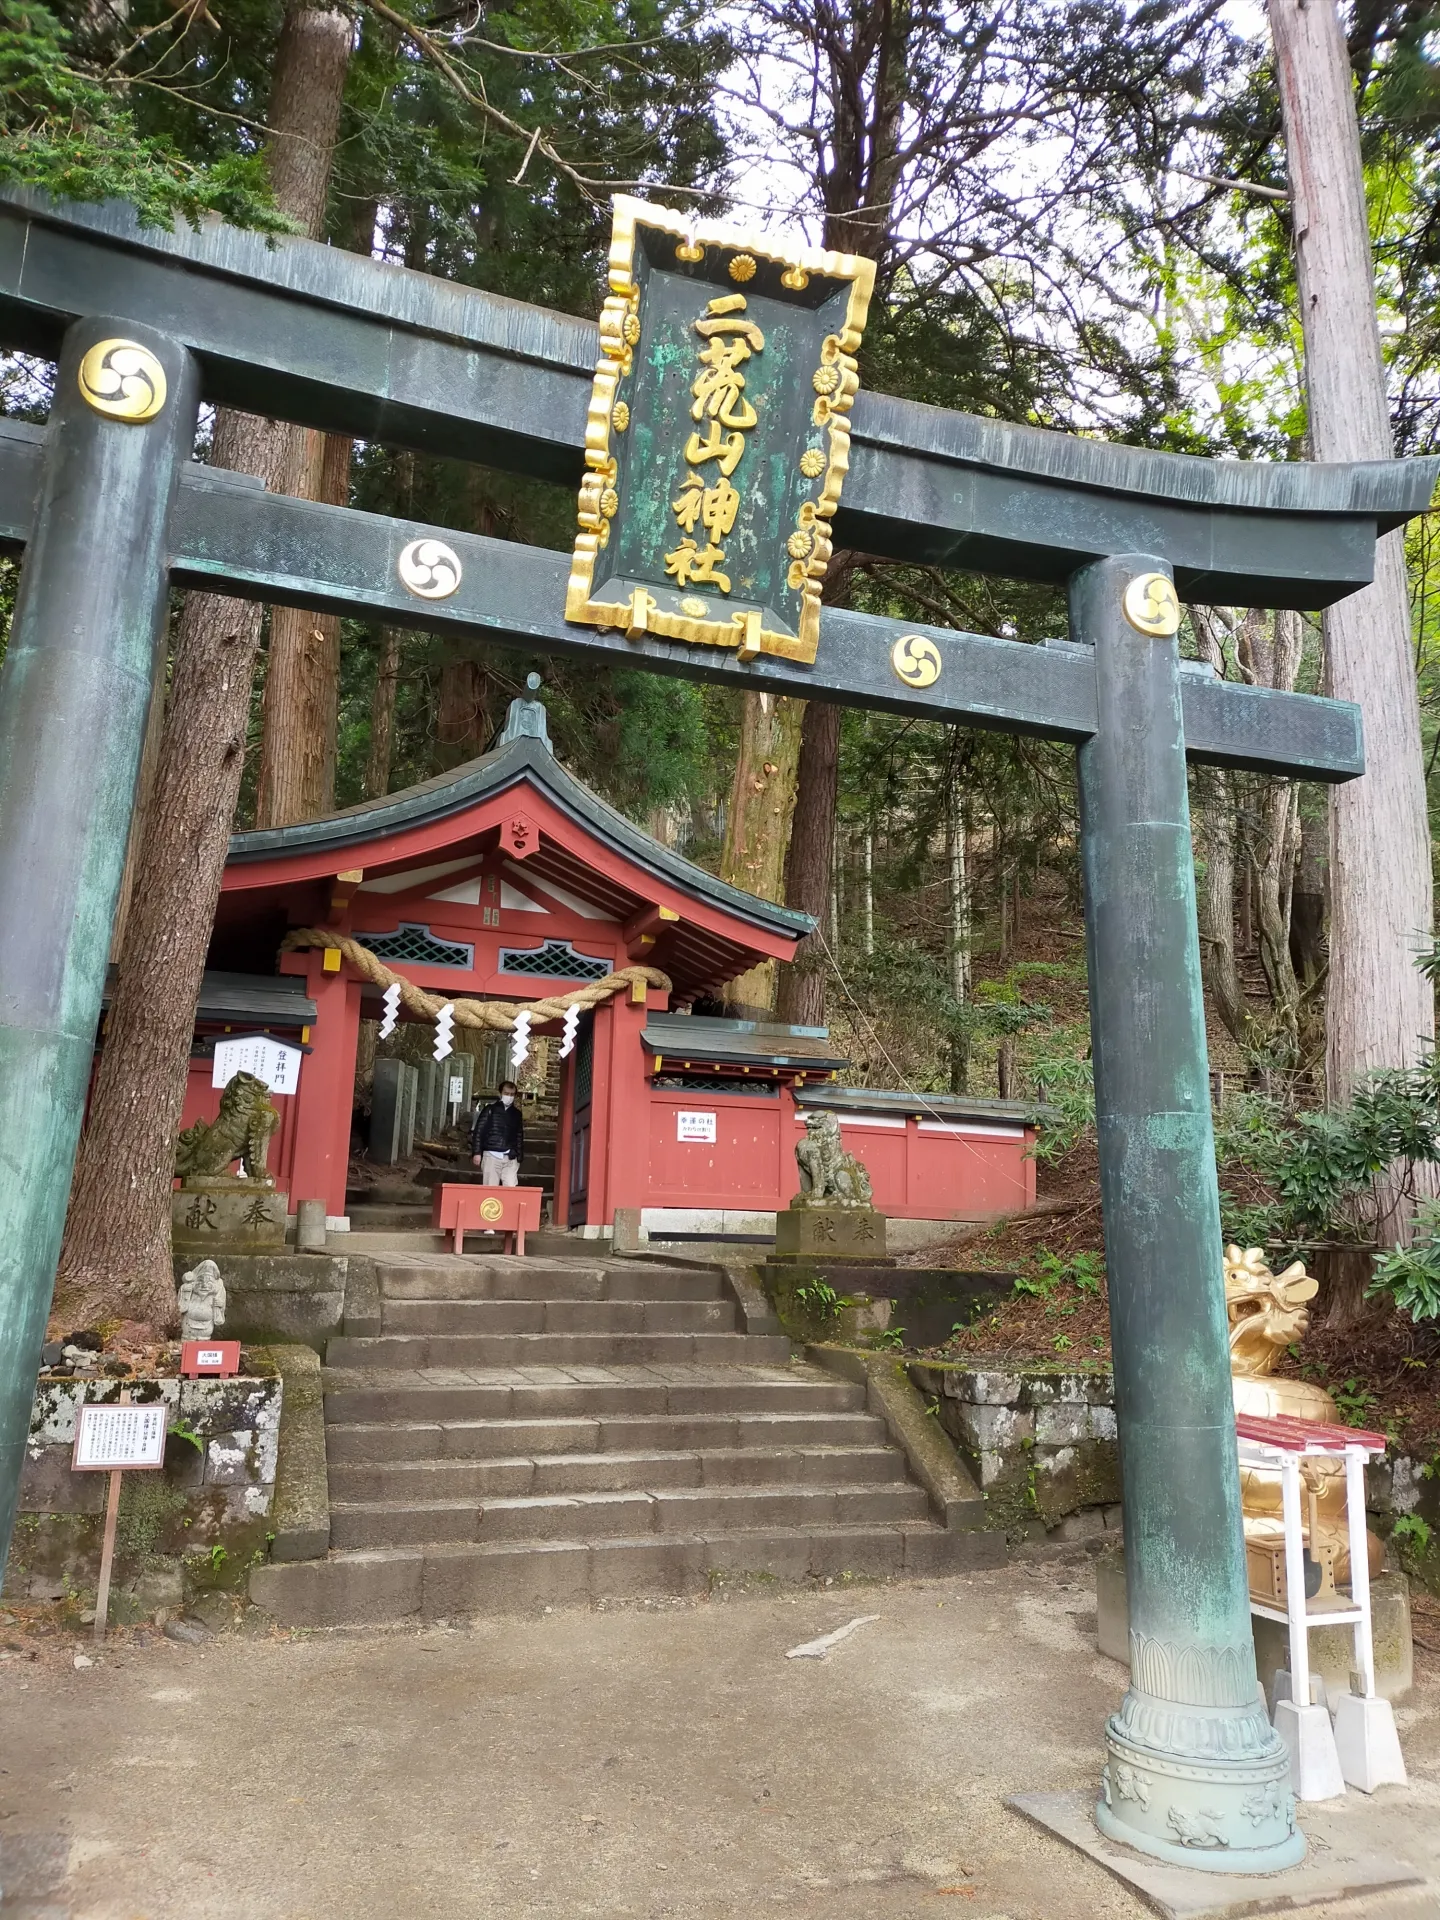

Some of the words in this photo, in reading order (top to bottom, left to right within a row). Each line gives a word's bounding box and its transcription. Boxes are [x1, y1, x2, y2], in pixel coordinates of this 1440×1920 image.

[664, 292, 766, 594] 二荒山神社
[274, 1049, 288, 1085] 登拝門
